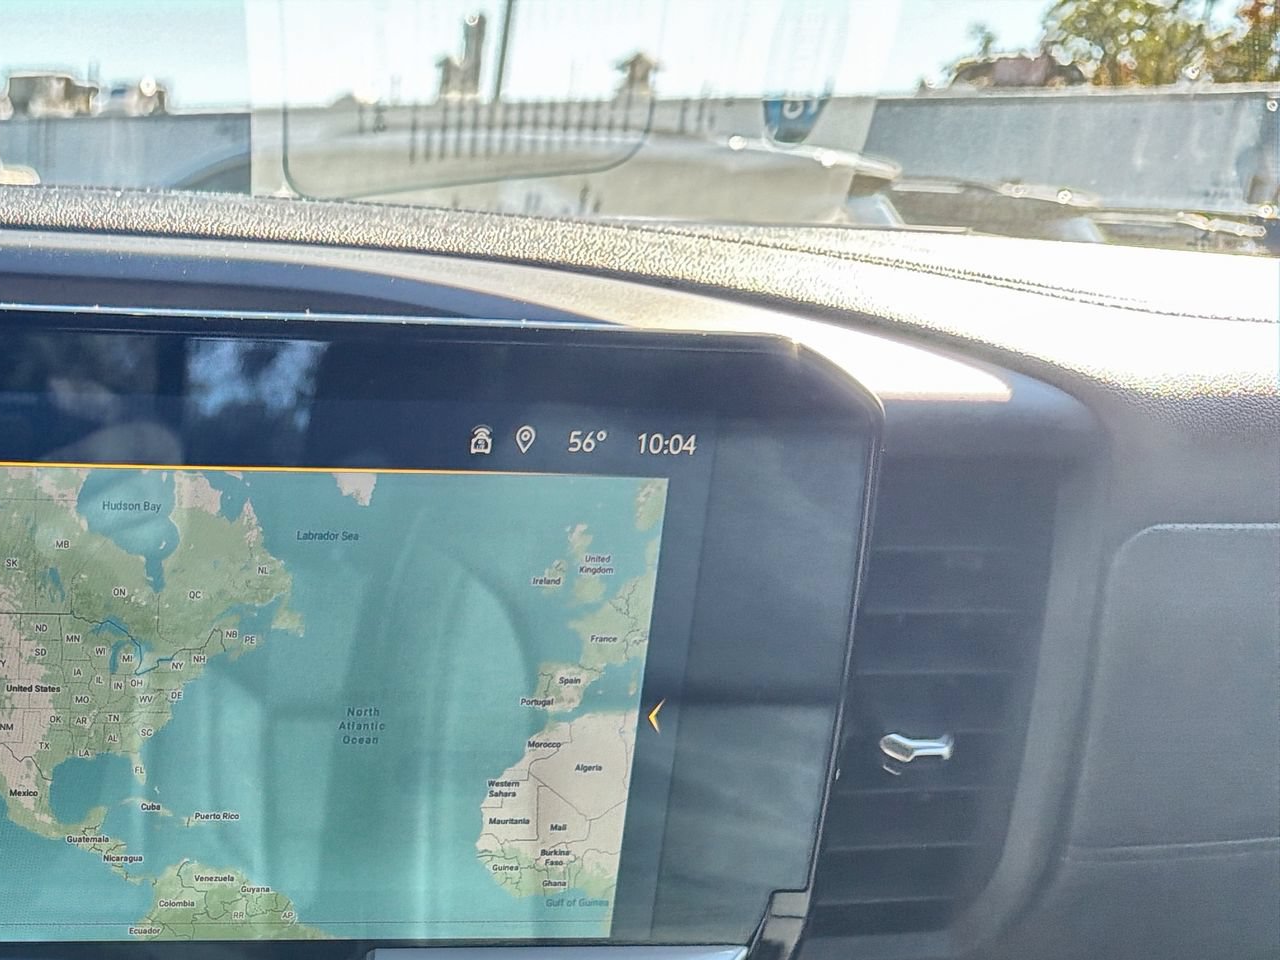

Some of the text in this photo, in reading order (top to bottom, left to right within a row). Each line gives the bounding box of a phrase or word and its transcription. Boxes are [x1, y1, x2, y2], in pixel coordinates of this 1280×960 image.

[638, 433, 697, 455] 10:04
[102, 501, 161, 513] Hudson Bay
[297, 531, 359, 541] Labrador Sea
[55, 540, 69, 548] MB
[585, 555, 611, 563] United
[258, 566, 269, 575] NL
[579, 566, 614, 575] Kingdom
[532, 577, 561, 585] Ireland
[113, 588, 126, 597] ON
[189, 591, 201, 600] QC
[591, 635, 617, 643] France
[559, 676, 581, 686] Spain
[35, 685, 61, 693] States
[520, 698, 554, 707] Portugal
[347, 707, 380, 717] North
[339, 722, 385, 731] Atlantic
[343, 735, 379, 745] Ocean
[528, 740, 561, 749] Morocco
[575, 763, 602, 773] Algeria
[488, 780, 520, 788] Western
[10, 789, 38, 798] Mexico
[489, 790, 516, 798] Sahara
[141, 802, 161, 811] Cuba
[195, 812, 239, 820] Puerto Rico
[489, 817, 530, 825] Mauritania
[550, 823, 567, 832] Mali
[67, 835, 109, 844] Guatemala
[540, 848, 570, 857] Burkina
[103, 854, 143, 863] Nicaragua
[545, 858, 563, 867] Faso
[492, 863, 519, 872] Guinea
[194, 874, 234, 883] Venezuela
[542, 879, 567, 888] Ghana
[241, 885, 270, 894] Guyana
[159, 899, 195, 908] Colombia
[546, 898, 609, 907] Gulf of Guinea
[233, 911, 245, 919] RR
[282, 911, 293, 920] AP
[129, 926, 160, 935] Ecuador
